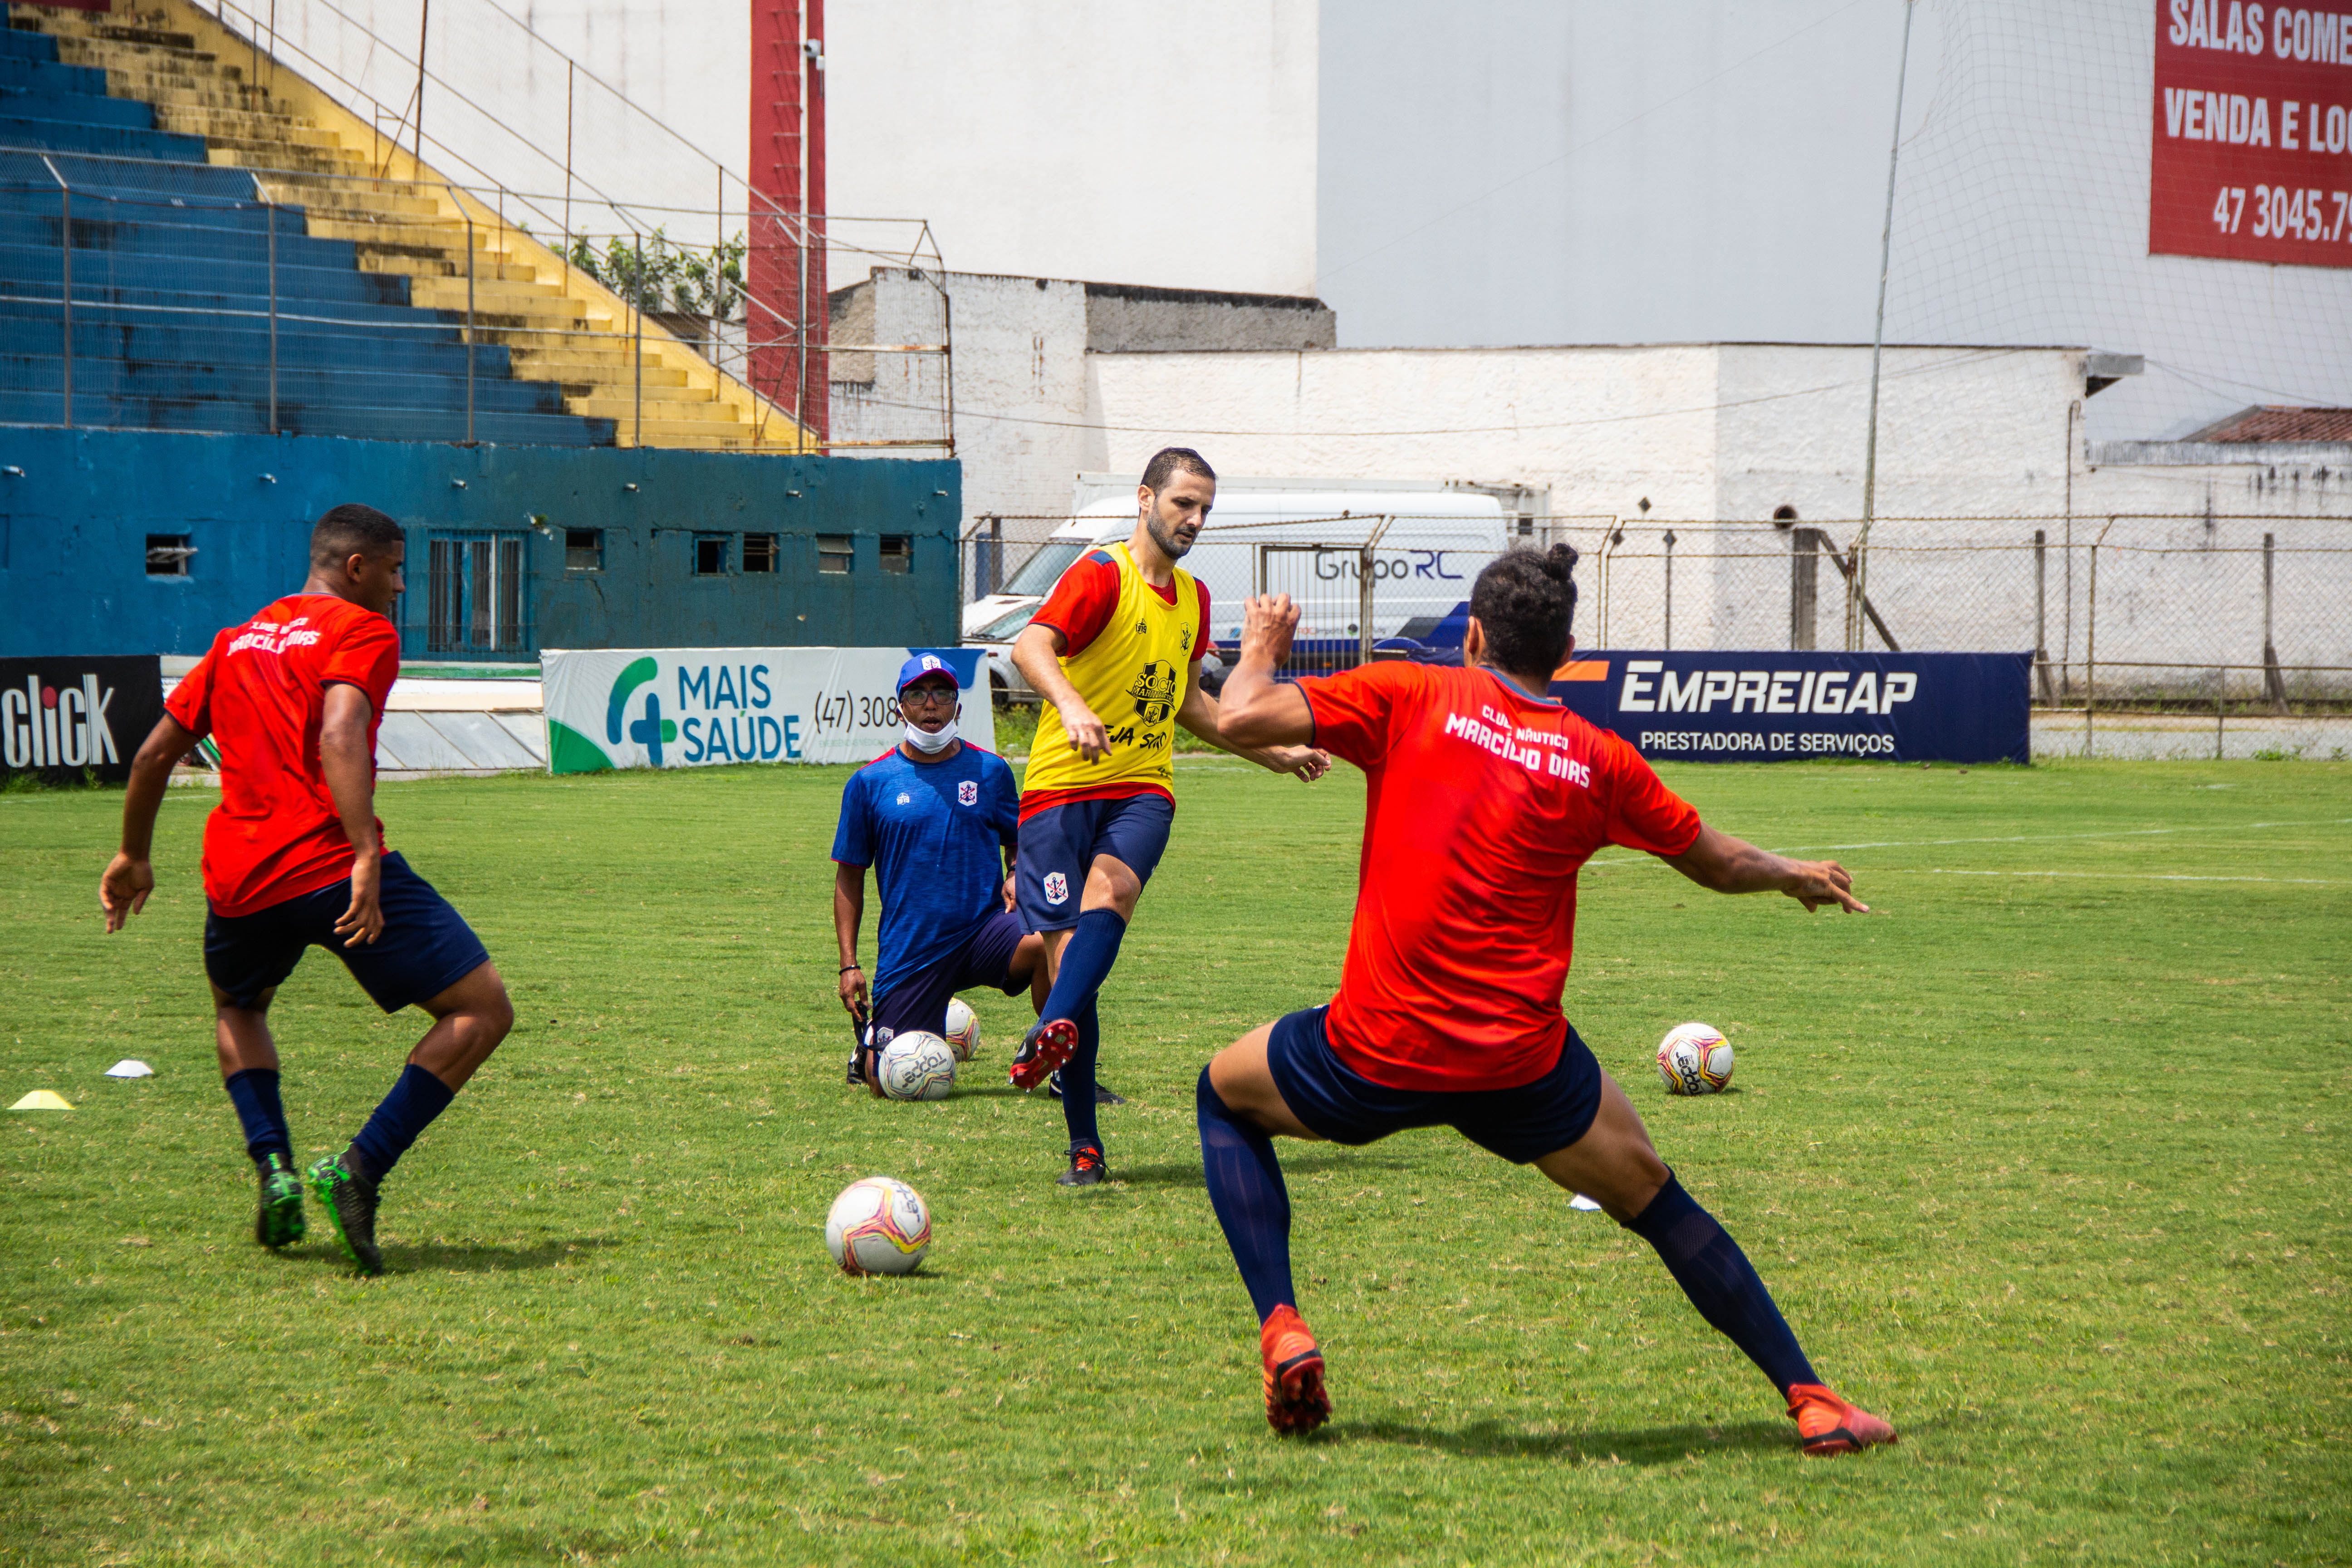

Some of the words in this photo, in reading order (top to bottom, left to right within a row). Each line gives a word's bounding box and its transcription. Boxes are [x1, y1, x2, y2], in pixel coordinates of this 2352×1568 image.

[2169, 0, 2264, 55] SALAS
[2165, 88, 2271, 147] VENDA
[2282, 100, 2300, 149] E
[2309, 103, 2352, 153] LO
[2213, 186, 2246, 234] 47
[2253, 184, 2352, 242] 3045.7
[1136, 624, 1147, 634] 1919
[678, 665, 771, 710] MAIS
[1134, 671, 1176, 696] SÓCIO
[1619, 660, 1918, 714] EMPREIGAP
[1, 673, 120, 768] click
[682, 710, 802, 762] SAÚDE
[815, 690, 853, 734] (47)
[1445, 712, 1541, 771] MARCÍLIO
[1548, 753, 1591, 789] DIAS
[1640, 731, 1766, 751] PRESTADORA
[1770, 733, 1795, 751] DE
[1799, 734, 1895, 757] SERVIÇOS
